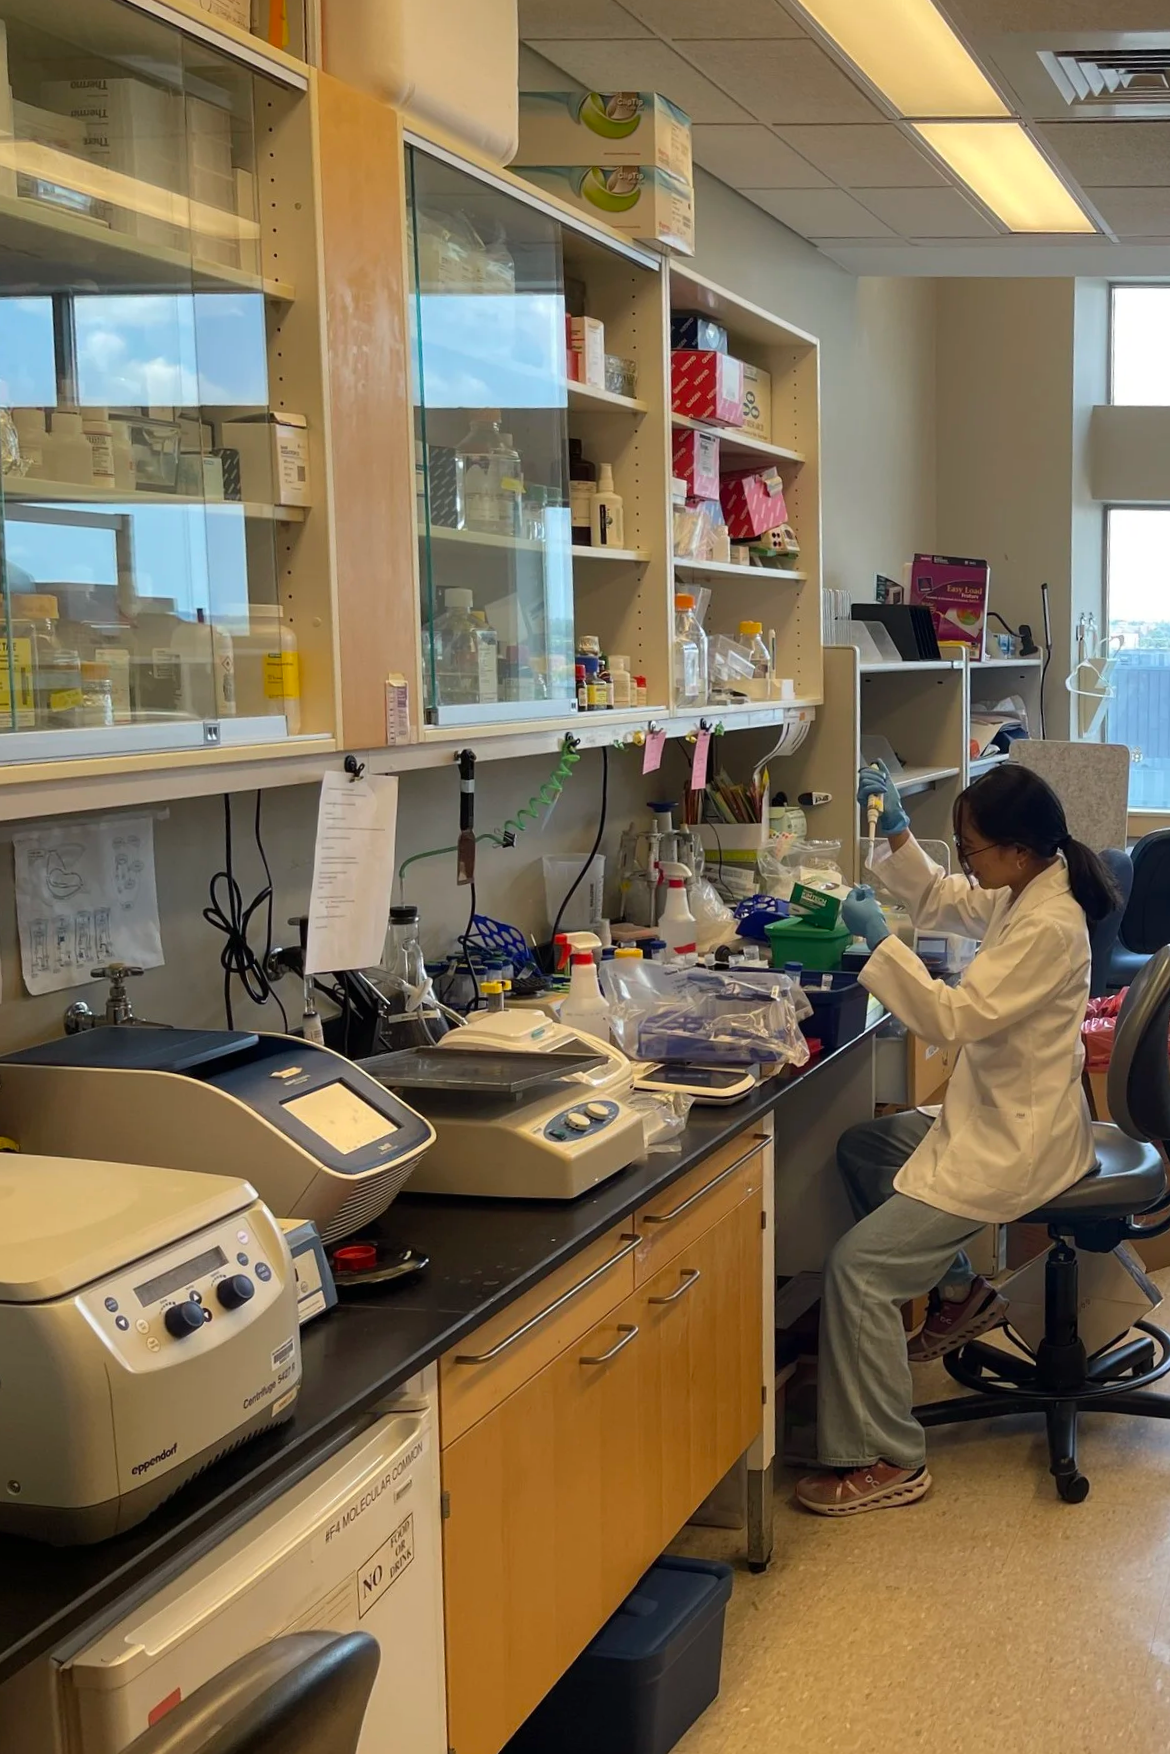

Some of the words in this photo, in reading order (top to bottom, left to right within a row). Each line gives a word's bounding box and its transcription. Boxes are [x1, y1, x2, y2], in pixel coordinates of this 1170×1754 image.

[70, 79, 109, 90] Thermo
[616, 97, 645, 108] ClipTip
[83, 137, 110, 147] Ther
[617, 172, 645, 182] ClipTip
[680, 355, 697, 372] QIAGEN
[673, 377, 689, 394] QIAGEN
[693, 369, 710, 386] QIAGEN
[686, 391, 702, 408] QIAGEN
[946, 584, 962, 595] Easy
[965, 586, 983, 595] Load
[243, 1380, 277, 1409] Centrifuge
[277, 1371, 292, 1385] 5427
[131, 1442, 178, 1475] eppendorf
[325, 1521, 341, 1545] #F4
[342, 1474, 391, 1529] MOLECULAR
[392, 1442, 424, 1482] COMMON
[390, 1519, 411, 1549] FOOD
[395, 1539, 406, 1558] OR
[389, 1547, 412, 1579] DRINK
[362, 1564, 383, 1600] NO
